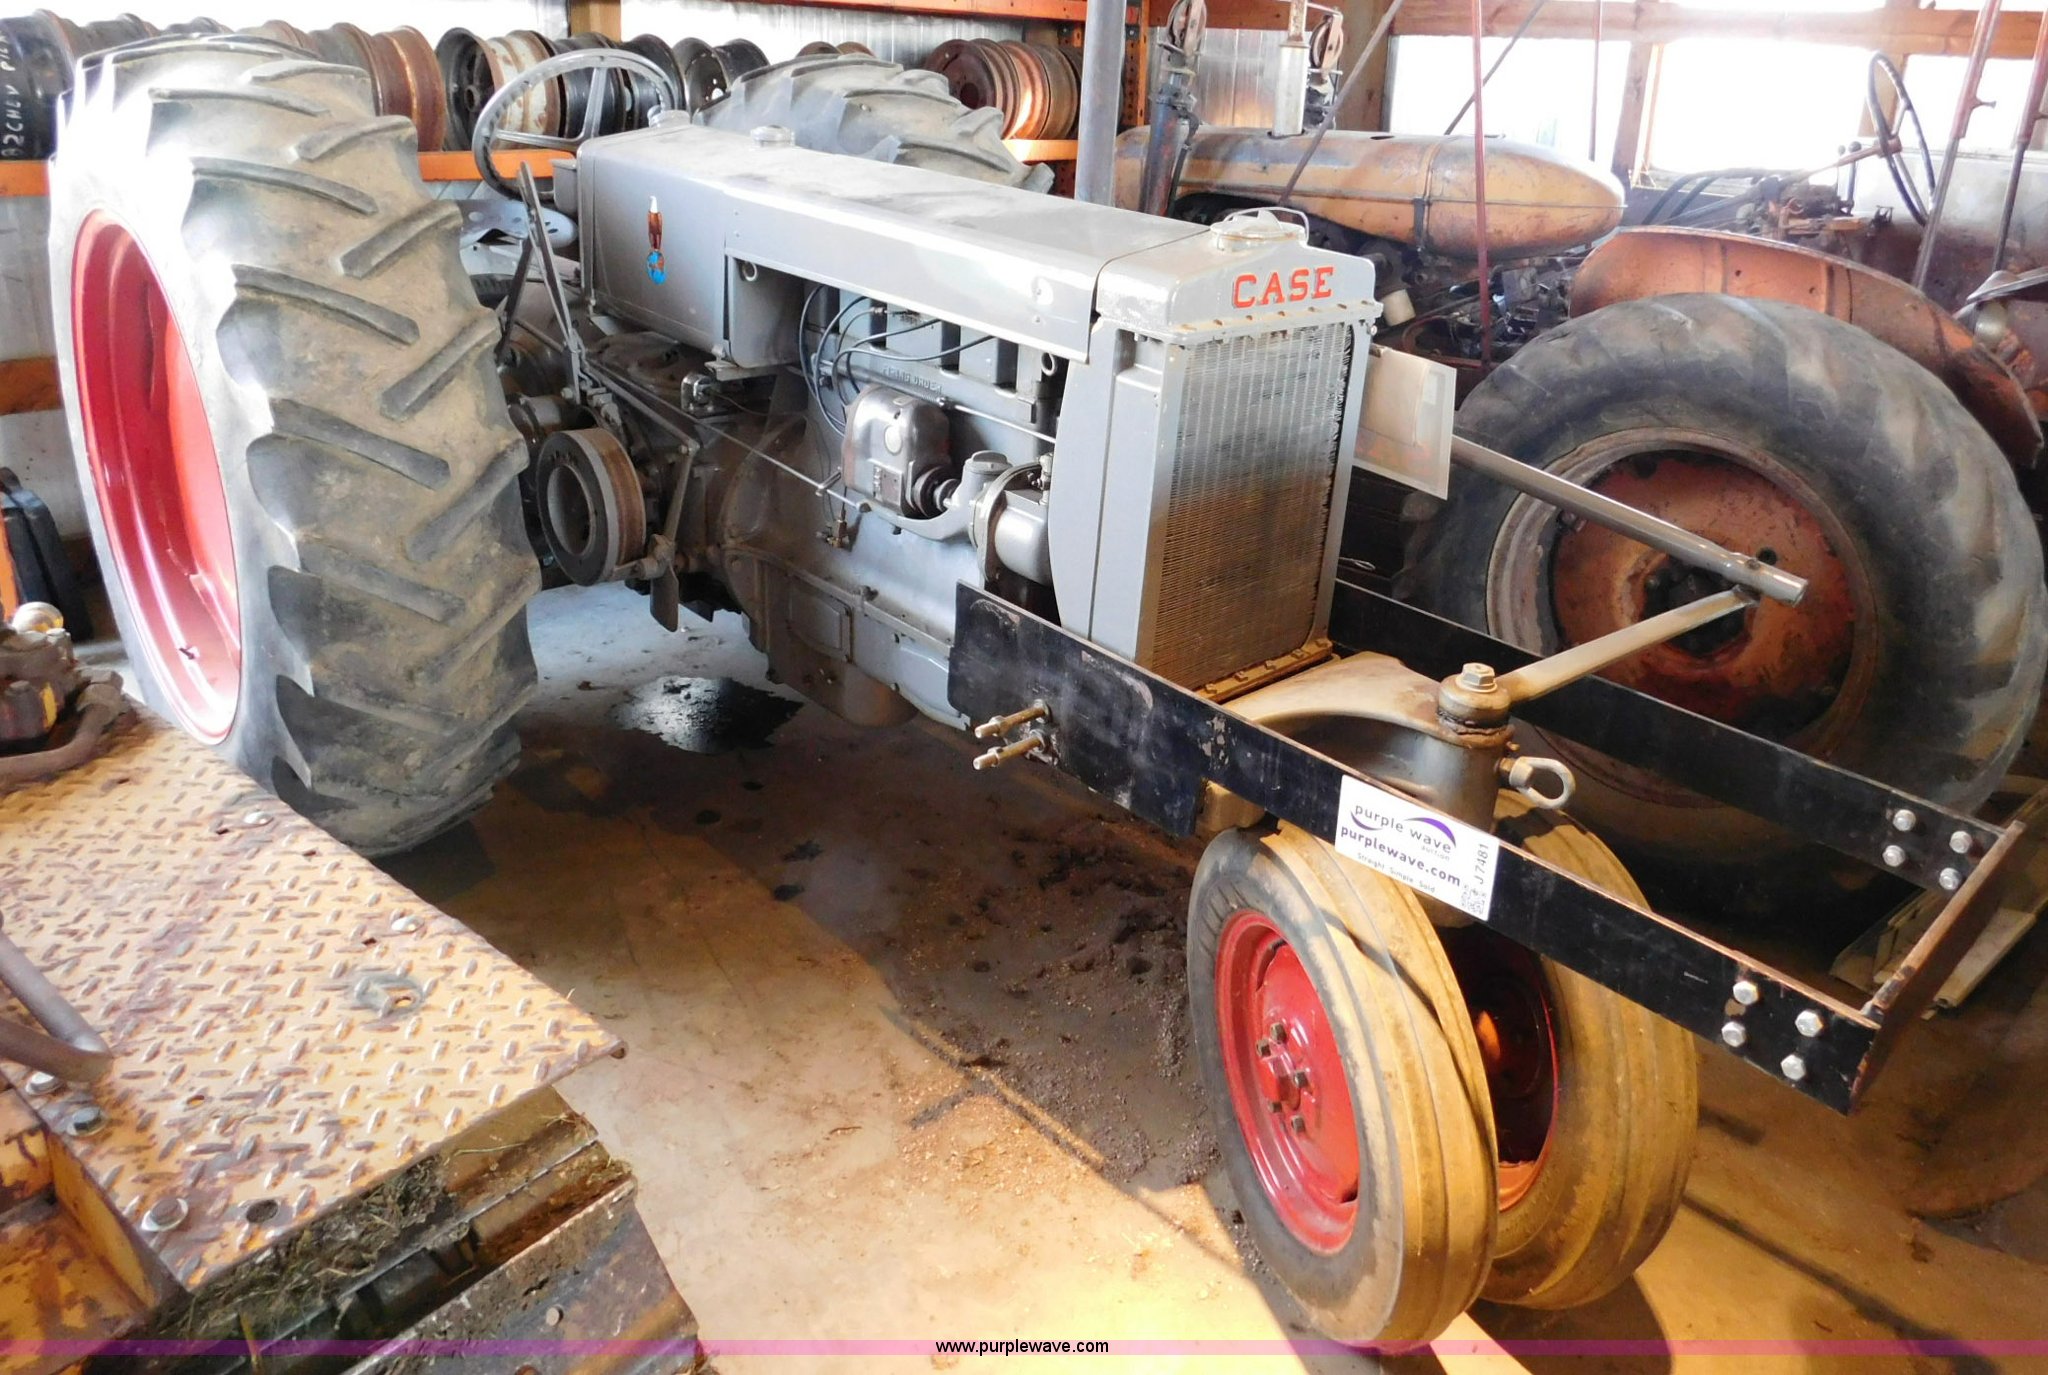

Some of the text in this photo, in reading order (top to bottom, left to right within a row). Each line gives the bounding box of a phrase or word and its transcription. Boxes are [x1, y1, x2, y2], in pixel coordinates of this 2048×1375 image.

[1232, 266, 1334, 309] CASE
[1355, 804, 1452, 854] purple wave
[1340, 825, 1461, 887] purplewave.com
[1418, 880, 1436, 893] Sold
